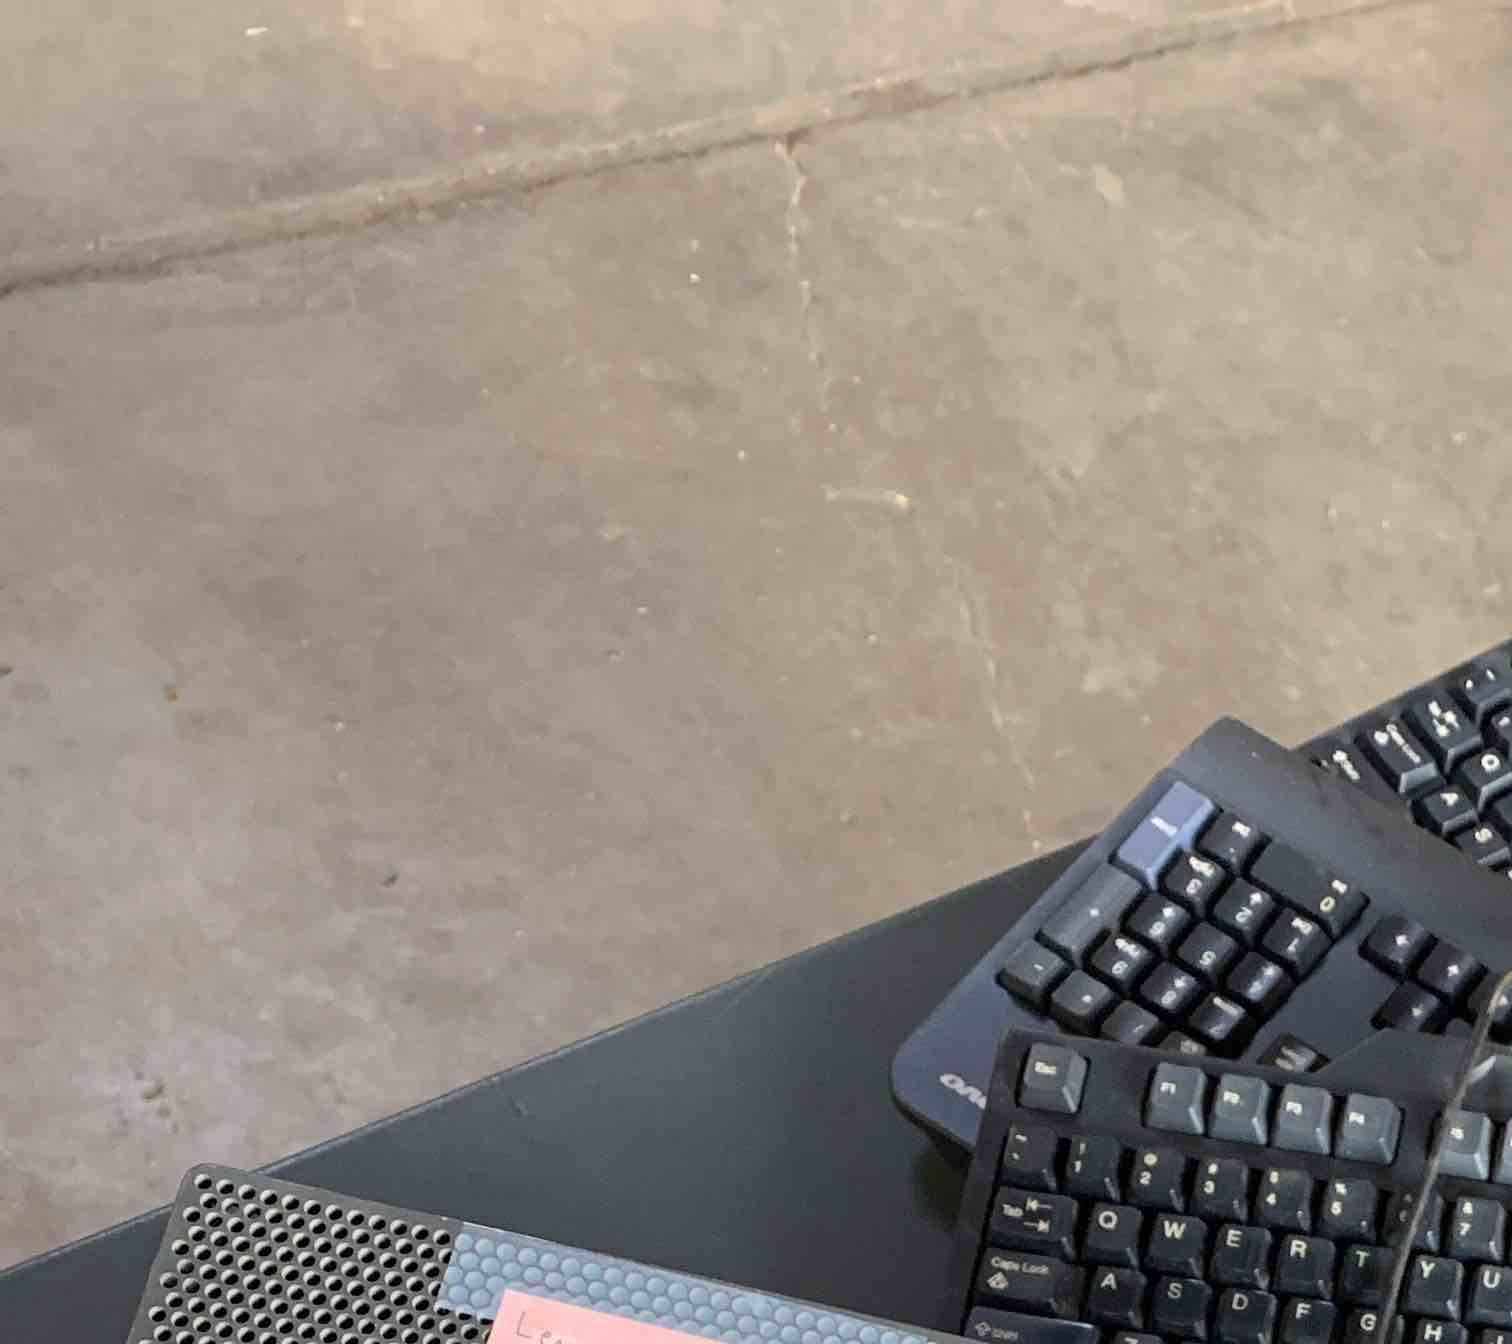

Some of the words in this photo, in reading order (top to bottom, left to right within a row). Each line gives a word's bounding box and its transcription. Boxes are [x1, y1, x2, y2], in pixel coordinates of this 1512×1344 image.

[1073, 1161, 1082, 1173] 1
[1139, 1172, 1151, 1184] 2
[1204, 1180, 1215, 1193] 3
[1266, 1193, 1277, 1205] 4
[1330, 1202, 1341, 1215] 5
[1098, 1211, 1118, 1229] Q
[1164, 1222, 1185, 1239] W
[1459, 1223, 1470, 1235] 7
[1226, 1230, 1242, 1247] E
[1290, 1240, 1308, 1258] R
[1355, 1250, 1370, 1268] T
[1420, 1261, 1435, 1279] Y
[1101, 1273, 1117, 1290] A
[1484, 1271, 1500, 1288] U
[1168, 1283, 1182, 1298] S
[1232, 1294, 1248, 1310] D
[1296, 1304, 1310, 1320] F
[1360, 1314, 1377, 1331] G
[1424, 1325, 1442, 1342] H
